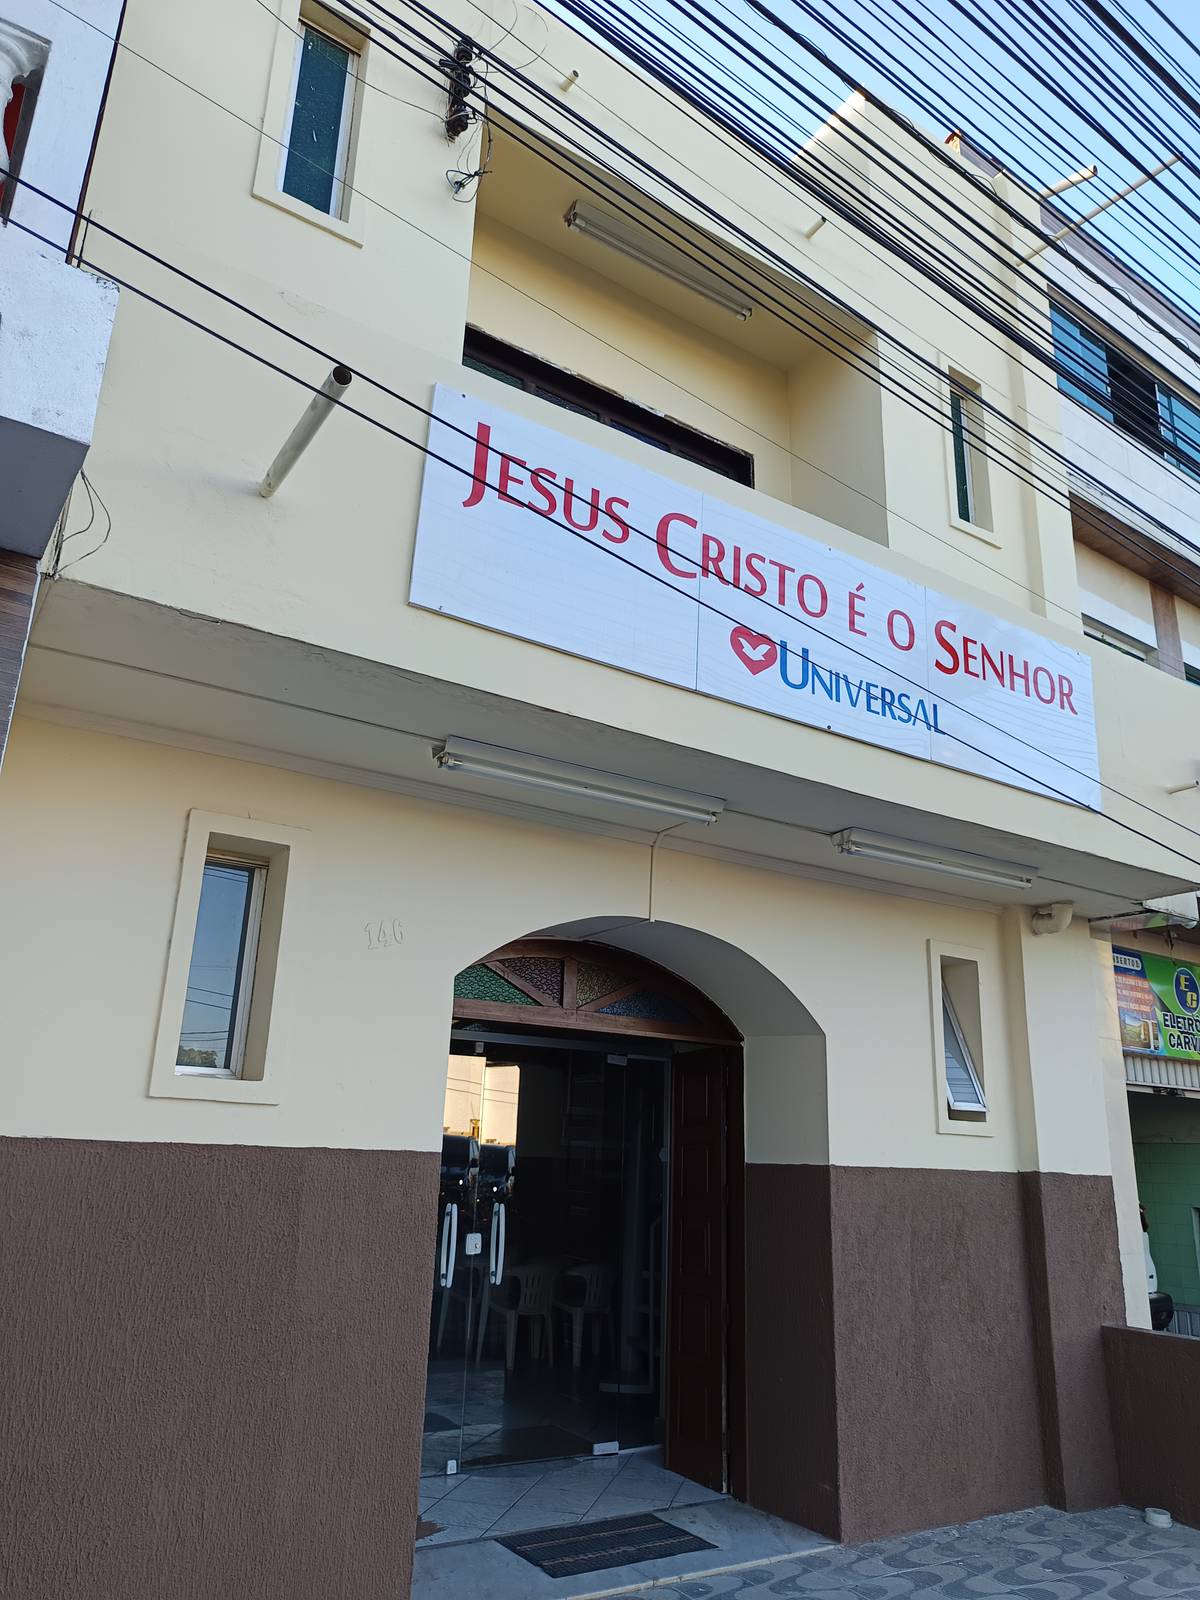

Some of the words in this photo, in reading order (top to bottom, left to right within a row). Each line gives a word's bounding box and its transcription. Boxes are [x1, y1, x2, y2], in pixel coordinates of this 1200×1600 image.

[463, 421, 630, 544] JESUS
[656, 512, 828, 618] CRISTO
[848, 582, 867, 637] É
[887, 609, 915, 651] O
[934, 619, 1078, 715] SENHOR
[779, 640, 948, 735] UNIVERSAL
[1168, 1032, 1200, 1053] CARV
